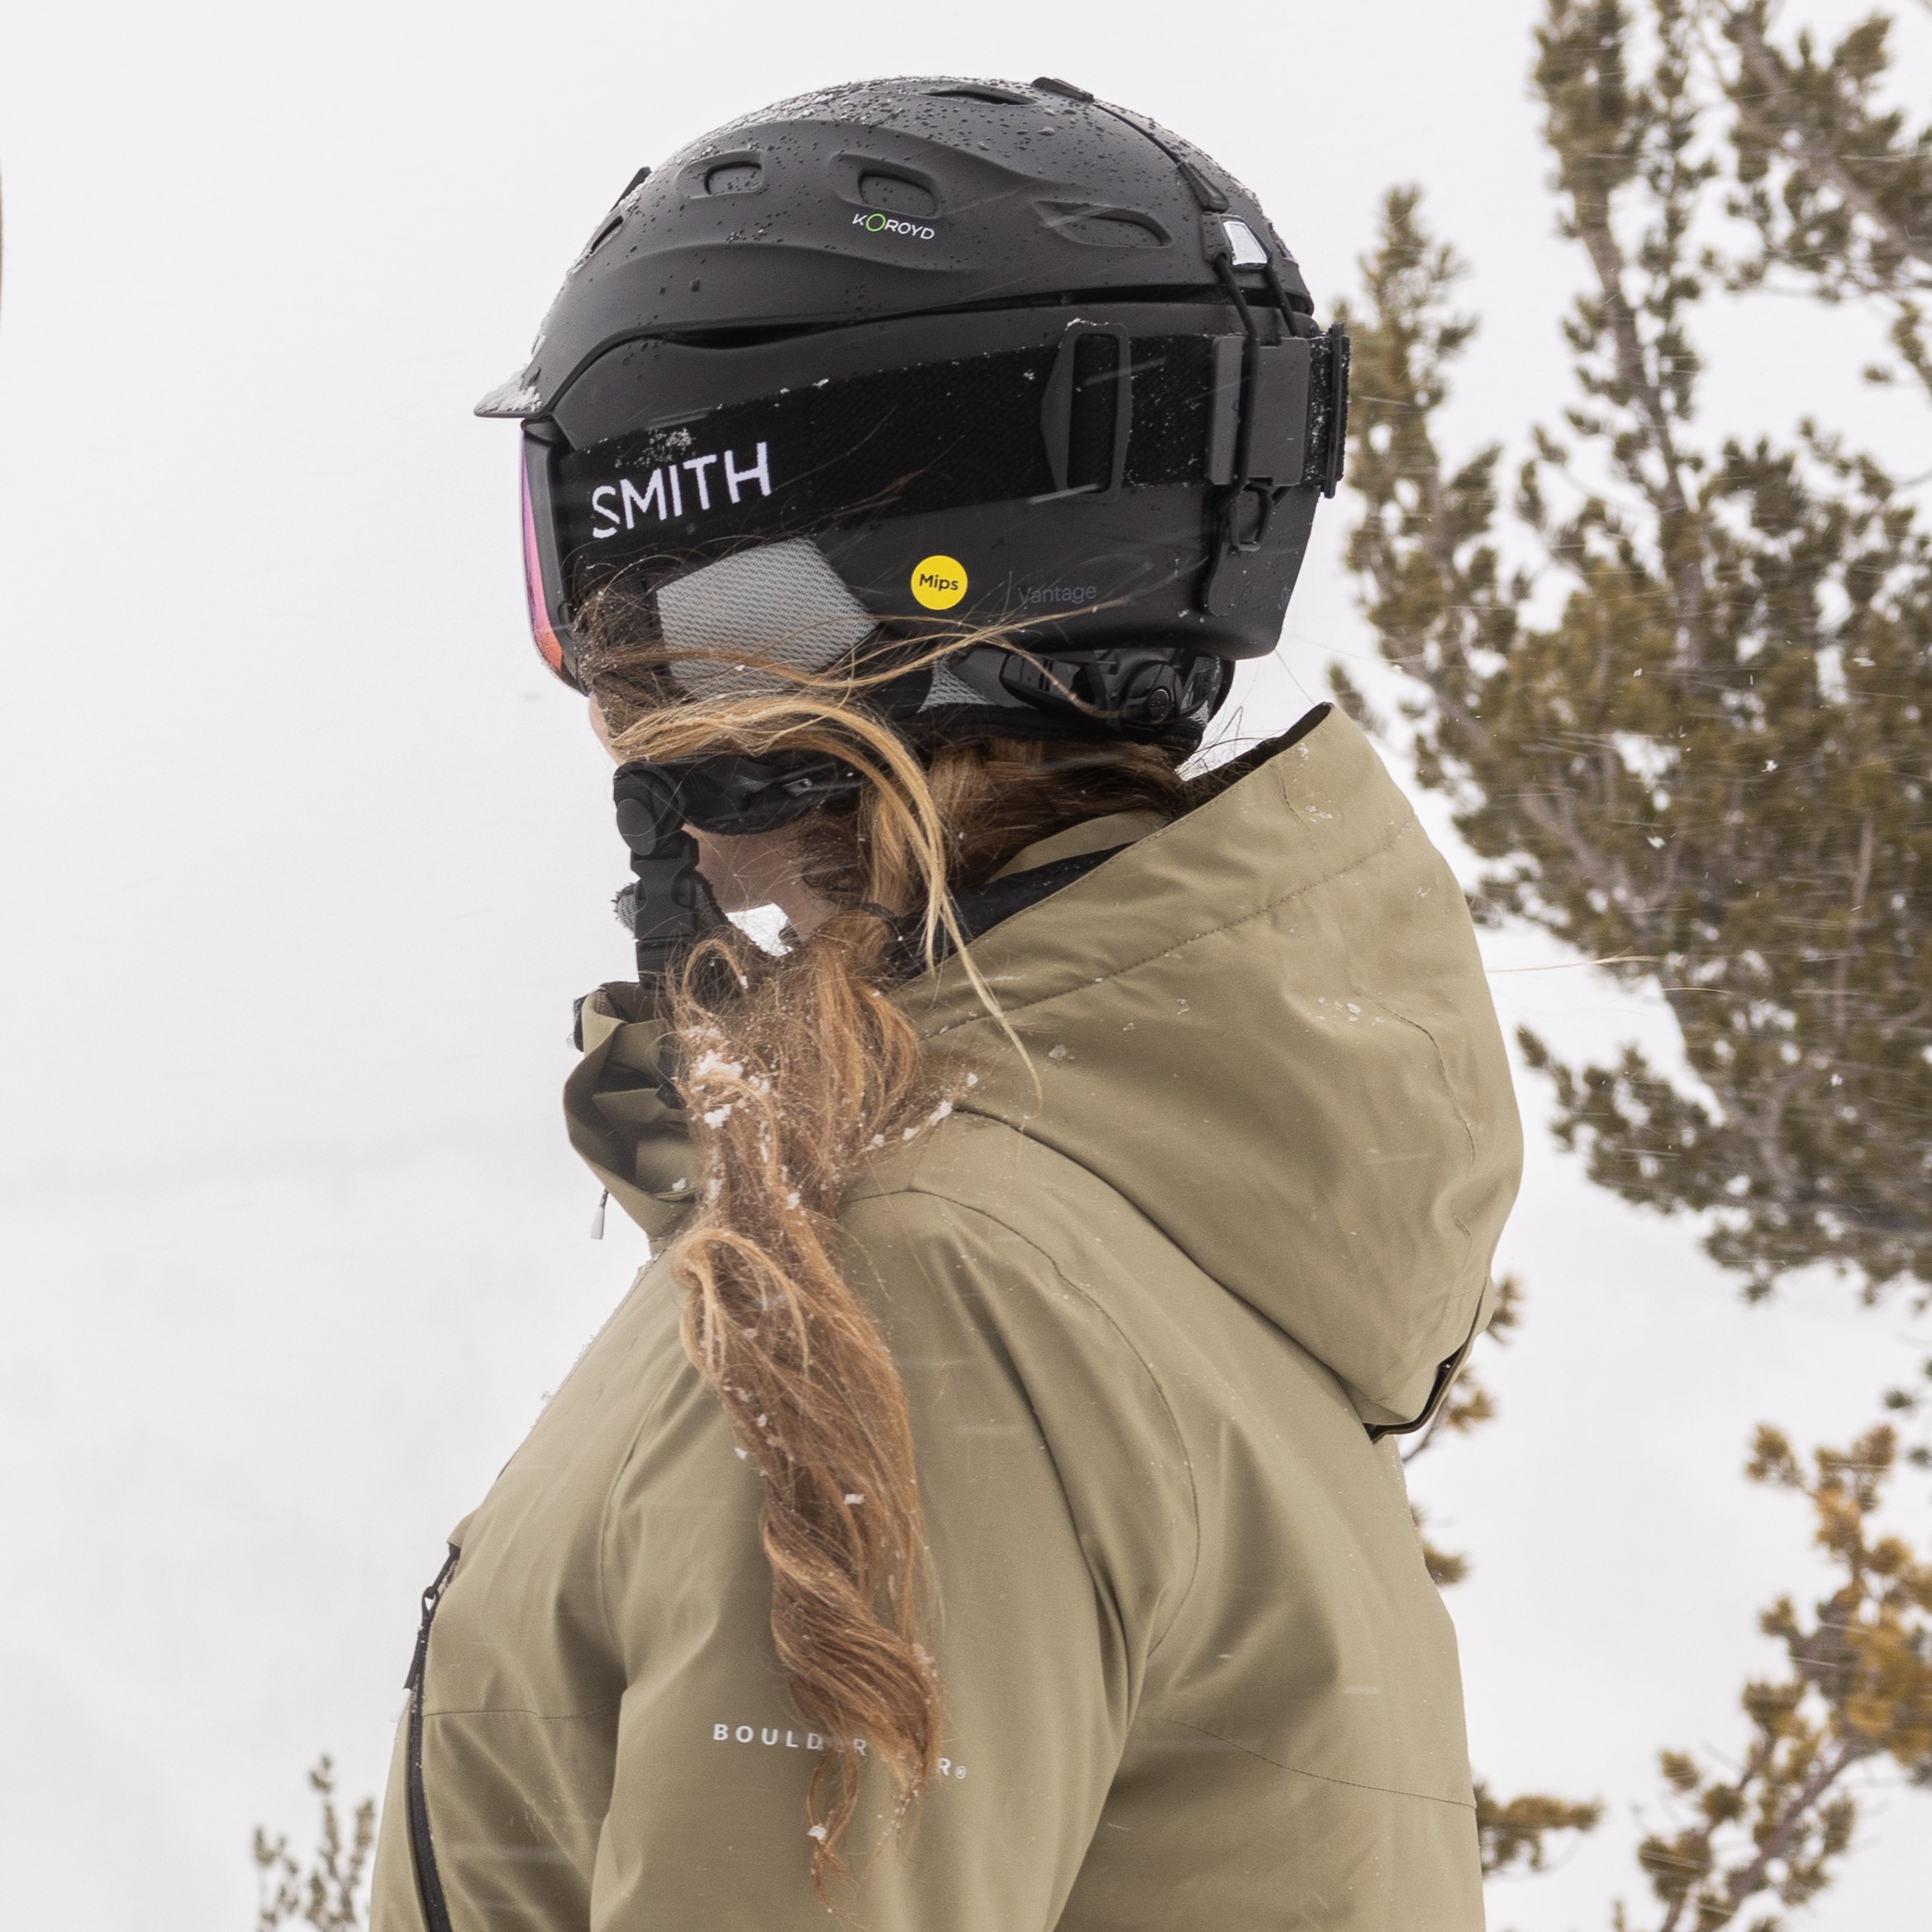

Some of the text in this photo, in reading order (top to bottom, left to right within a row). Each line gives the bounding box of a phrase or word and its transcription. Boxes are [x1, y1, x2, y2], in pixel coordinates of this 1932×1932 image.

[852, 213, 935, 240] KOROYD
[592, 441, 771, 539] SMITH
[919, 573, 959, 592] Mips
[1017, 585, 1097, 604] Vantage
[712, 1724, 868, 1756] BOULDR
